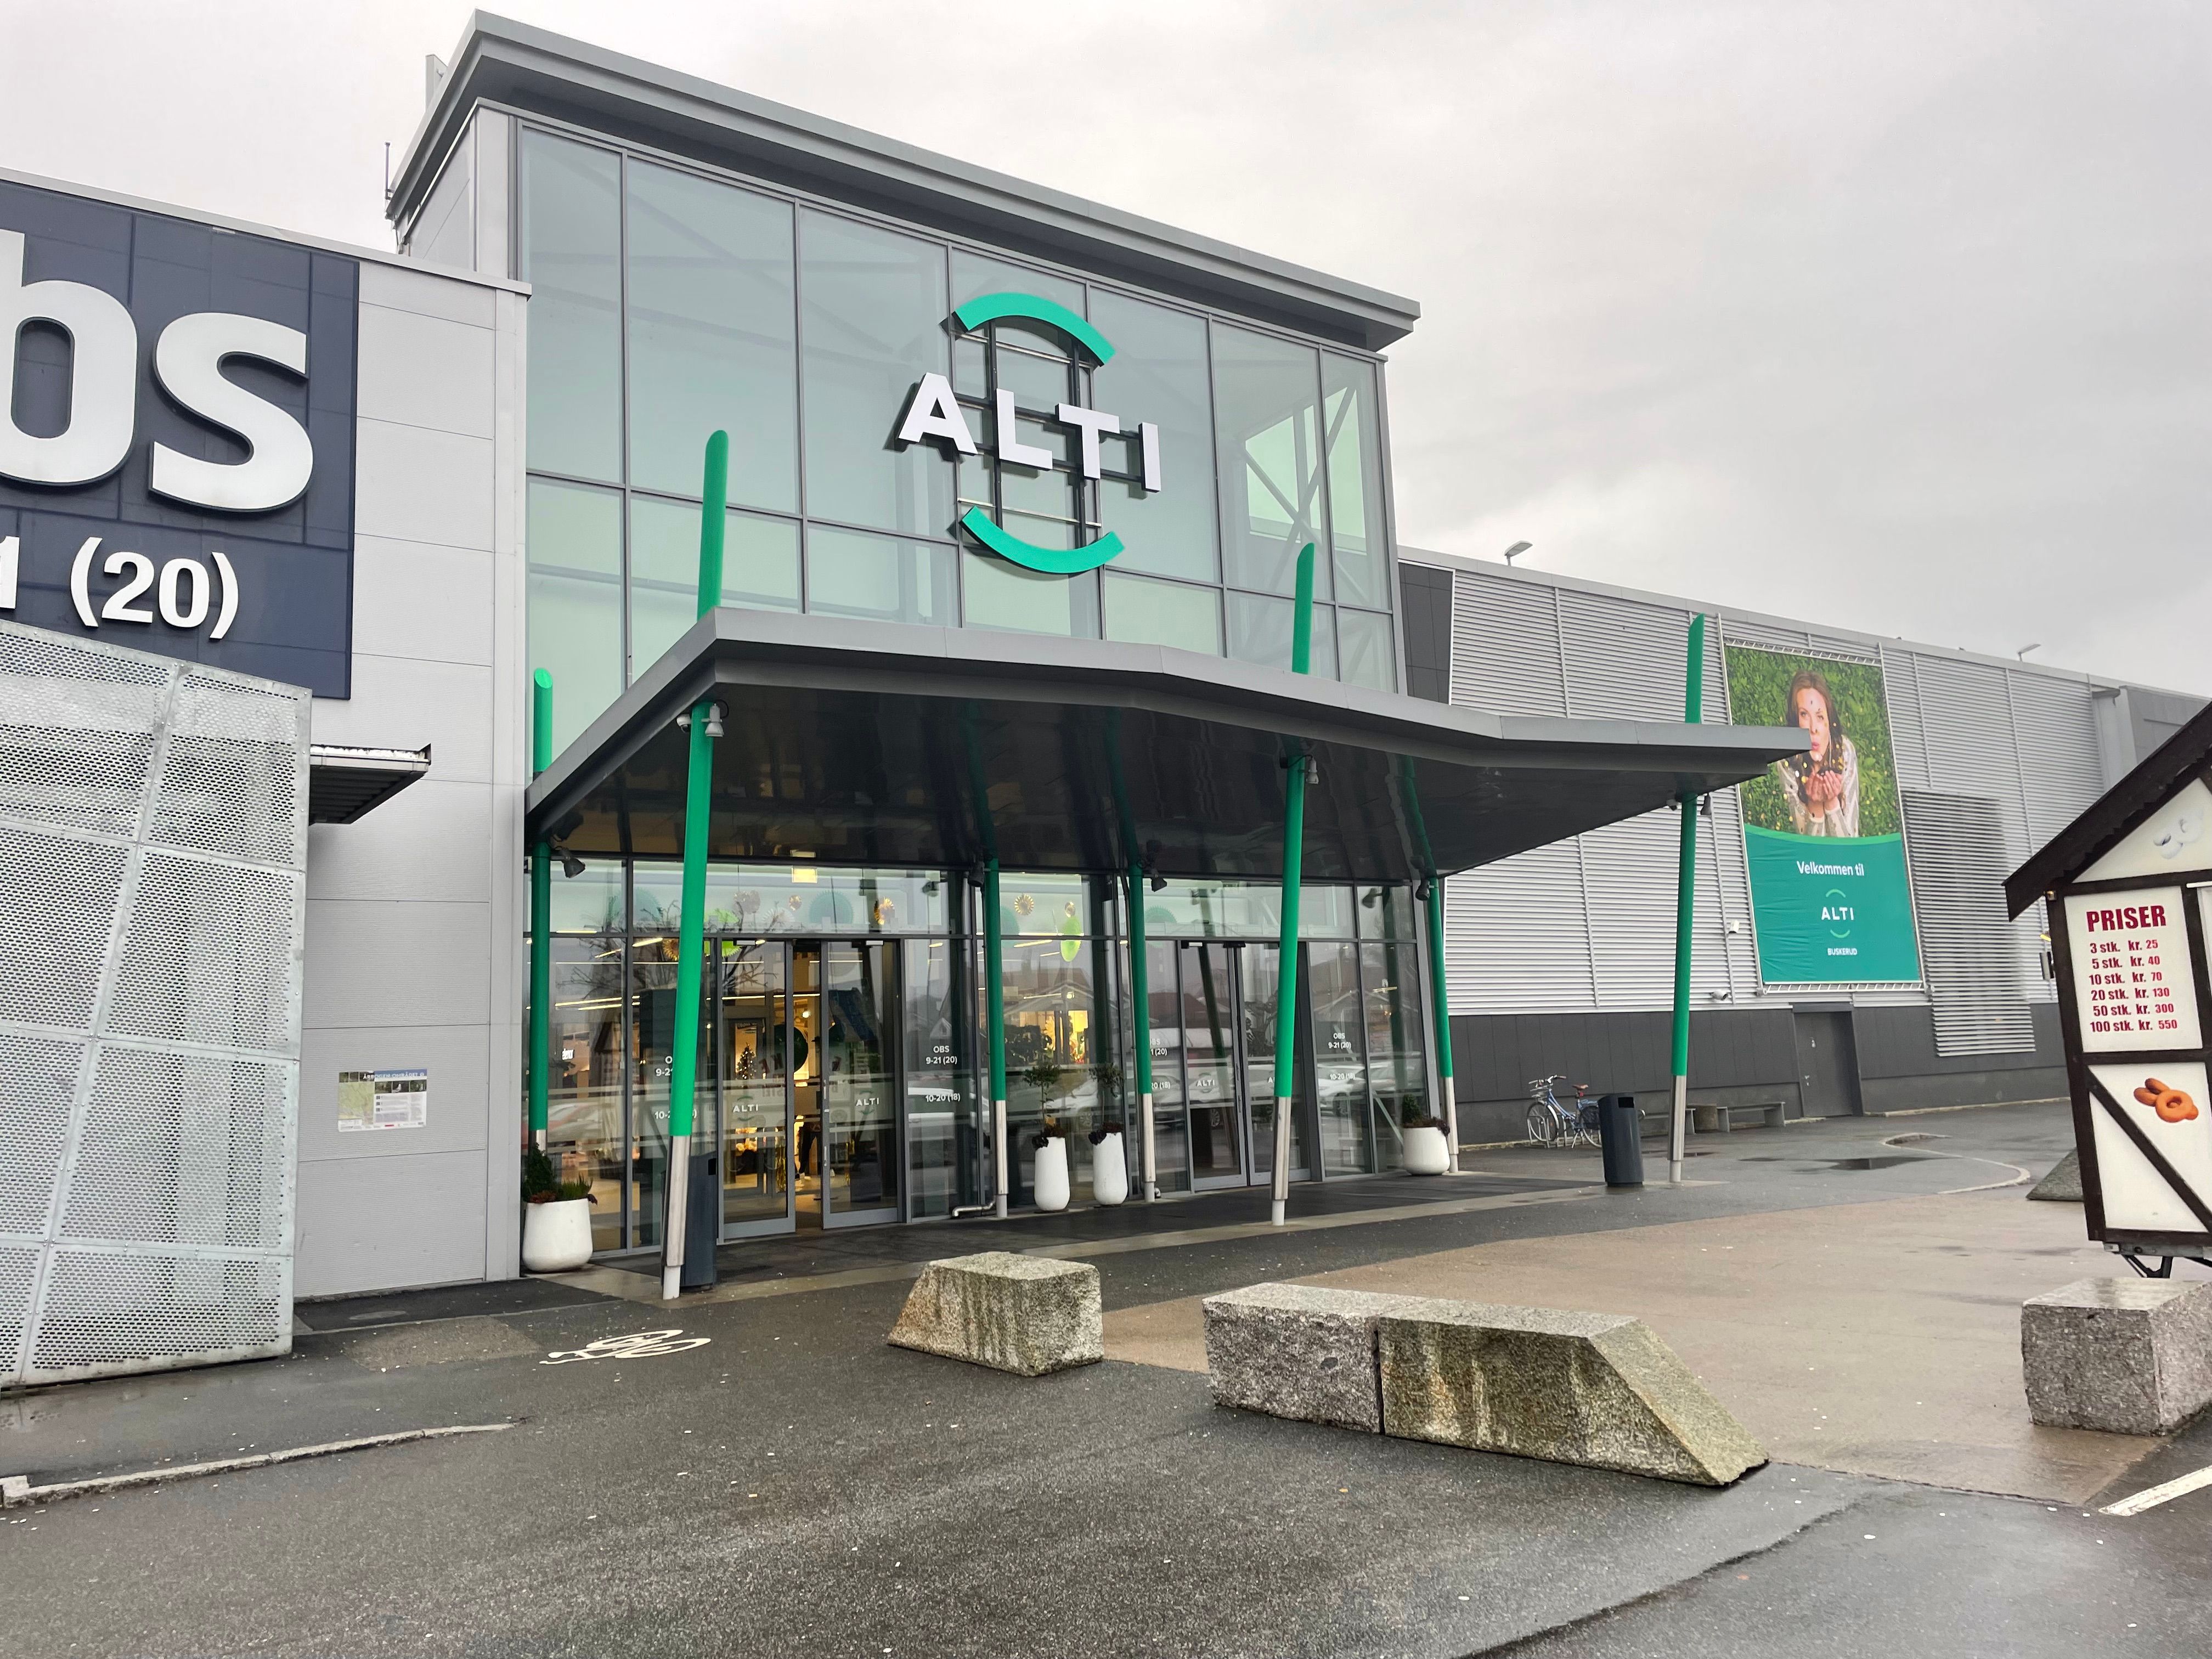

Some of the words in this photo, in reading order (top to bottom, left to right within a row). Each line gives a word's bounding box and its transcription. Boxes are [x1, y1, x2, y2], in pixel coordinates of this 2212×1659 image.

[898, 372, 1161, 493] ALTI
[70, 536, 239, 640] (20)
[1796, 861, 1853, 876] Velkommen
[1855, 863, 1864, 876] til
[1821, 907, 1854, 921] ALTI
[2086, 905, 2166, 932] PRISER
[2090, 943, 2097, 953] 3
[2100, 941, 2120, 952] stk.
[2128, 940, 2142, 951] kr.
[2146, 940, 2158, 949] 25
[2092, 958, 2100, 969] 5
[2102, 957, 2123, 968] stk.
[2130, 956, 2144, 966] kr.
[2148, 956, 2160, 965] 40
[2089, 974, 2101, 985] 10
[2104, 973, 2125, 984] stk.
[2132, 972, 2146, 982] kr.
[2151, 972, 2162, 981] 70
[2091, 990, 2105, 1001] 20
[2108, 989, 2129, 1000] stk.
[2135, 988, 2149, 998] kr.
[2153, 988, 2169, 997] 130
[2093, 1005, 2108, 1016] 50
[2111, 1005, 2131, 1015] stk.
[2136, 1004, 2150, 1014] kr.
[2155, 1003, 2174, 1013] 300
[2090, 1021, 2110, 1032] 100
[2113, 1020, 2134, 1031] stk.
[2138, 1020, 2153, 1030] kr.
[2158, 1019, 2177, 1029] 550
[933, 1045, 950, 1053] OBS
[1155, 1048, 1167, 1057] (20)
[926, 1056, 941, 1064] 9-21
[943, 1056, 957, 1065] (20)
[856, 1097, 879, 1107] ALTI
[926, 1094, 946, 1102] 10-20
[948, 1092, 961, 1102] (18)
[732, 1104, 759, 1113] ALTI
